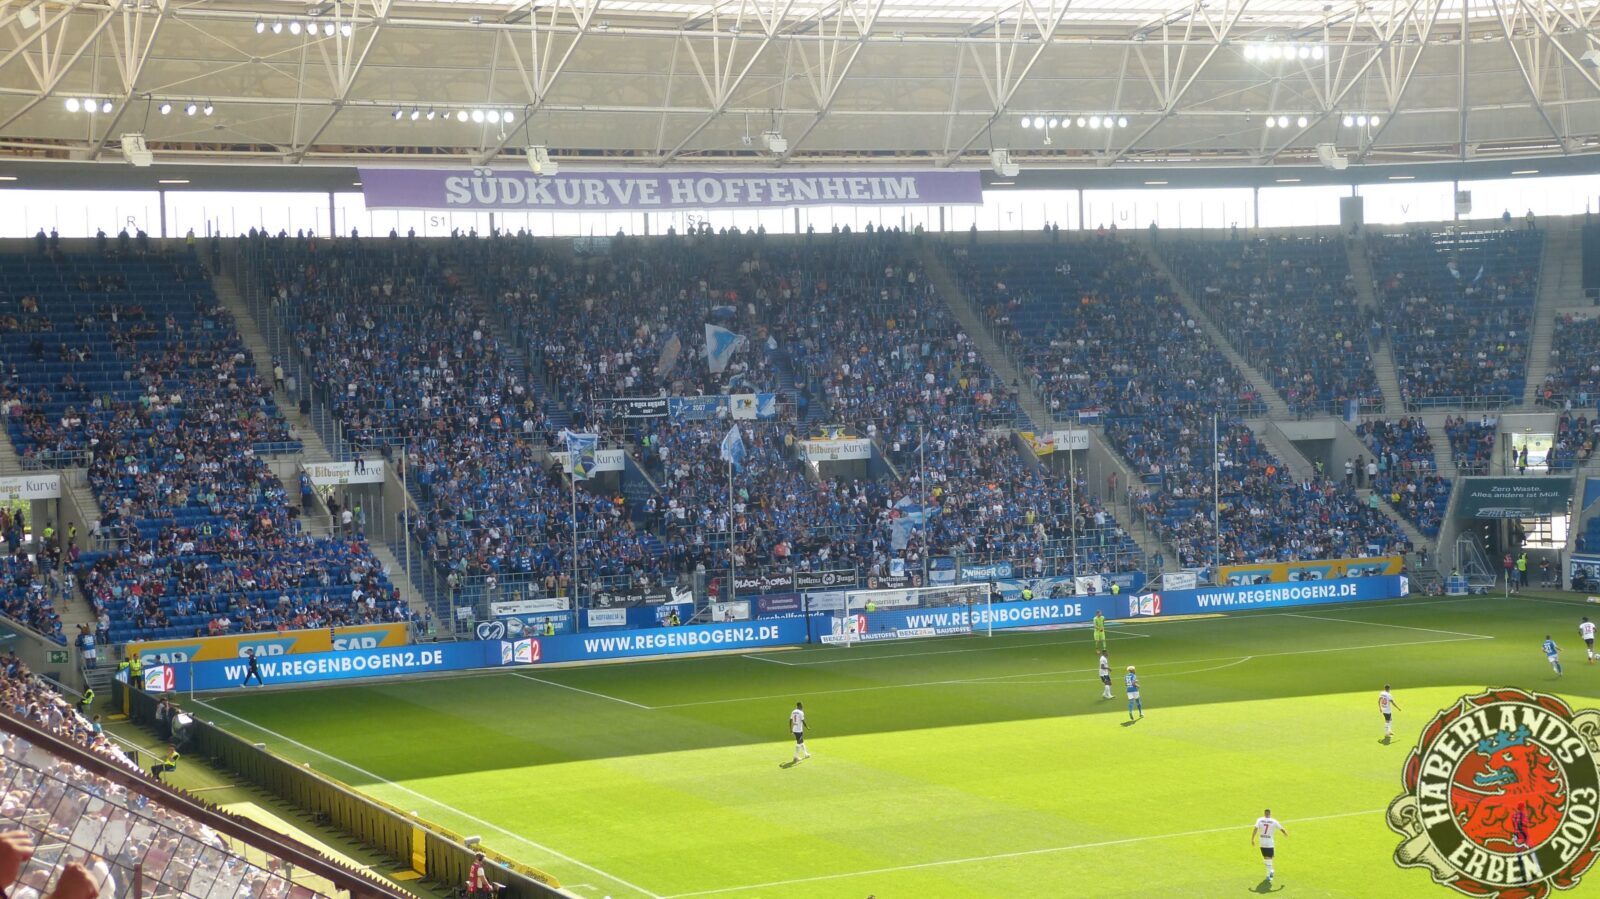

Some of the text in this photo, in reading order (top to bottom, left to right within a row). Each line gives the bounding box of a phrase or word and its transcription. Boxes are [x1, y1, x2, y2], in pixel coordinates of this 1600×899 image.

[445, 168, 920, 205] SÜDKURVE HOFFENHEIM
[430, 216, 446, 227] S1
[843, 443, 868, 453] Kurve
[596, 454, 622, 465] Kurve
[26, 480, 57, 491] Kurve
[1197, 583, 1356, 607] WWW.REGENBOGEN2.DE
[907, 604, 1082, 628] WWW.REGENBOGEN2.DE
[334, 637, 377, 650] SAP
[584, 625, 779, 653] WWW.REGENBOGEN2.DE
[532, 641, 540, 661] 2
[165, 667, 174, 690] 2
